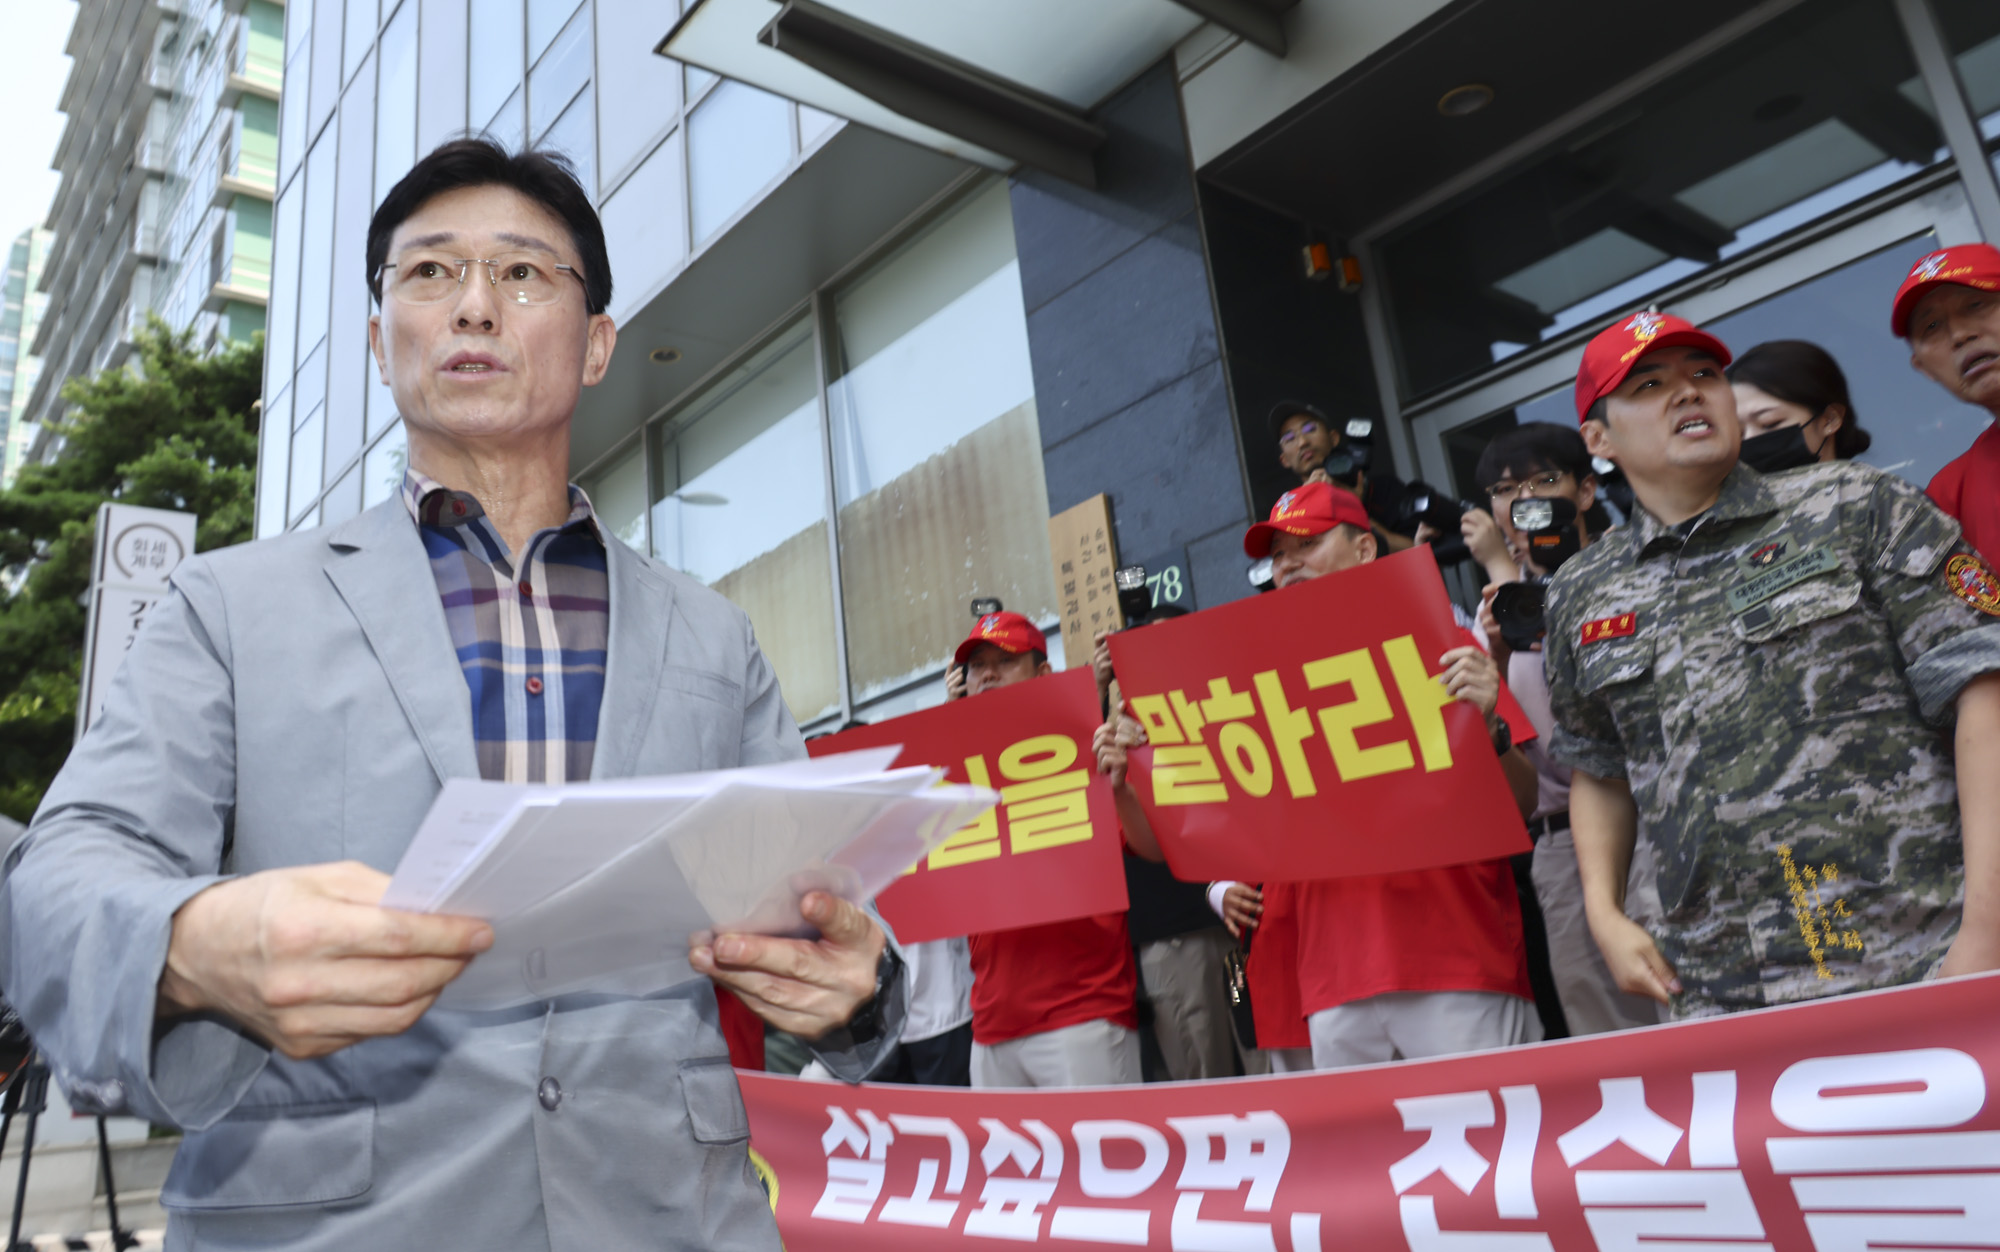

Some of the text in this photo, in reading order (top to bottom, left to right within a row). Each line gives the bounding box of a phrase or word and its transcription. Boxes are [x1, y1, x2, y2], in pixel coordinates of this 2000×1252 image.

[1145, 565, 1183, 609] 78
[1131, 634, 1457, 807] 말하라
[901, 733, 1093, 876] 실을
[1389, 1047, 2000, 1252] 진실을
